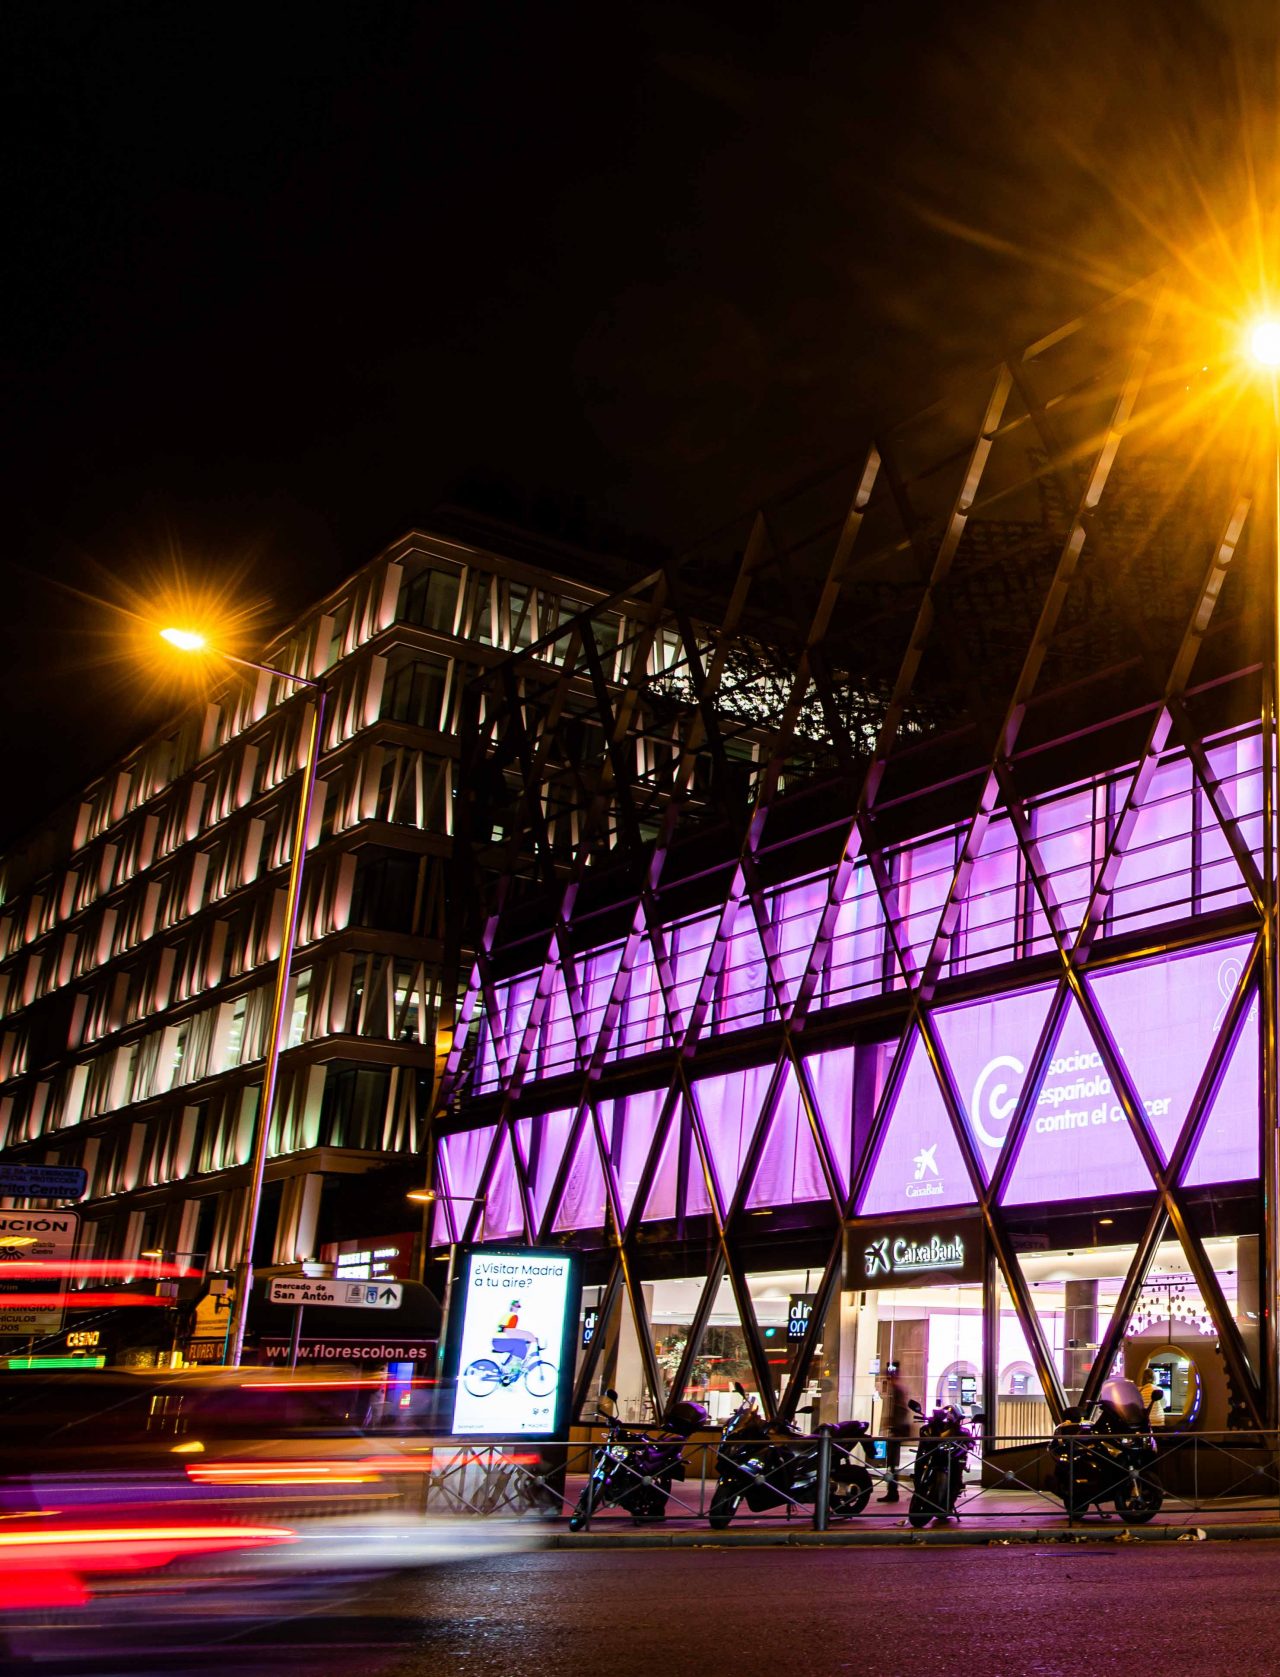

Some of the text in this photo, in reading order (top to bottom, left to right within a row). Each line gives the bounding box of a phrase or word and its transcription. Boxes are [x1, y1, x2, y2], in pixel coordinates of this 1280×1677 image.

[1037, 1076, 1111, 1108] española
[1036, 1098, 1171, 1133] contra el ccer
[0, 1183, 79, 1195] rito Centro
[893, 1235, 964, 1264] CaixaBank
[474, 1263, 563, 1276] ¿Visitar Madrid
[274, 1283, 311, 1291] mercado
[474, 1277, 533, 1288] a tu aire?
[273, 1290, 334, 1301] San Antón
[0, 1303, 56, 1312] TRINGIDO
[266, 1343, 427, 1360] www.florescolon.es
